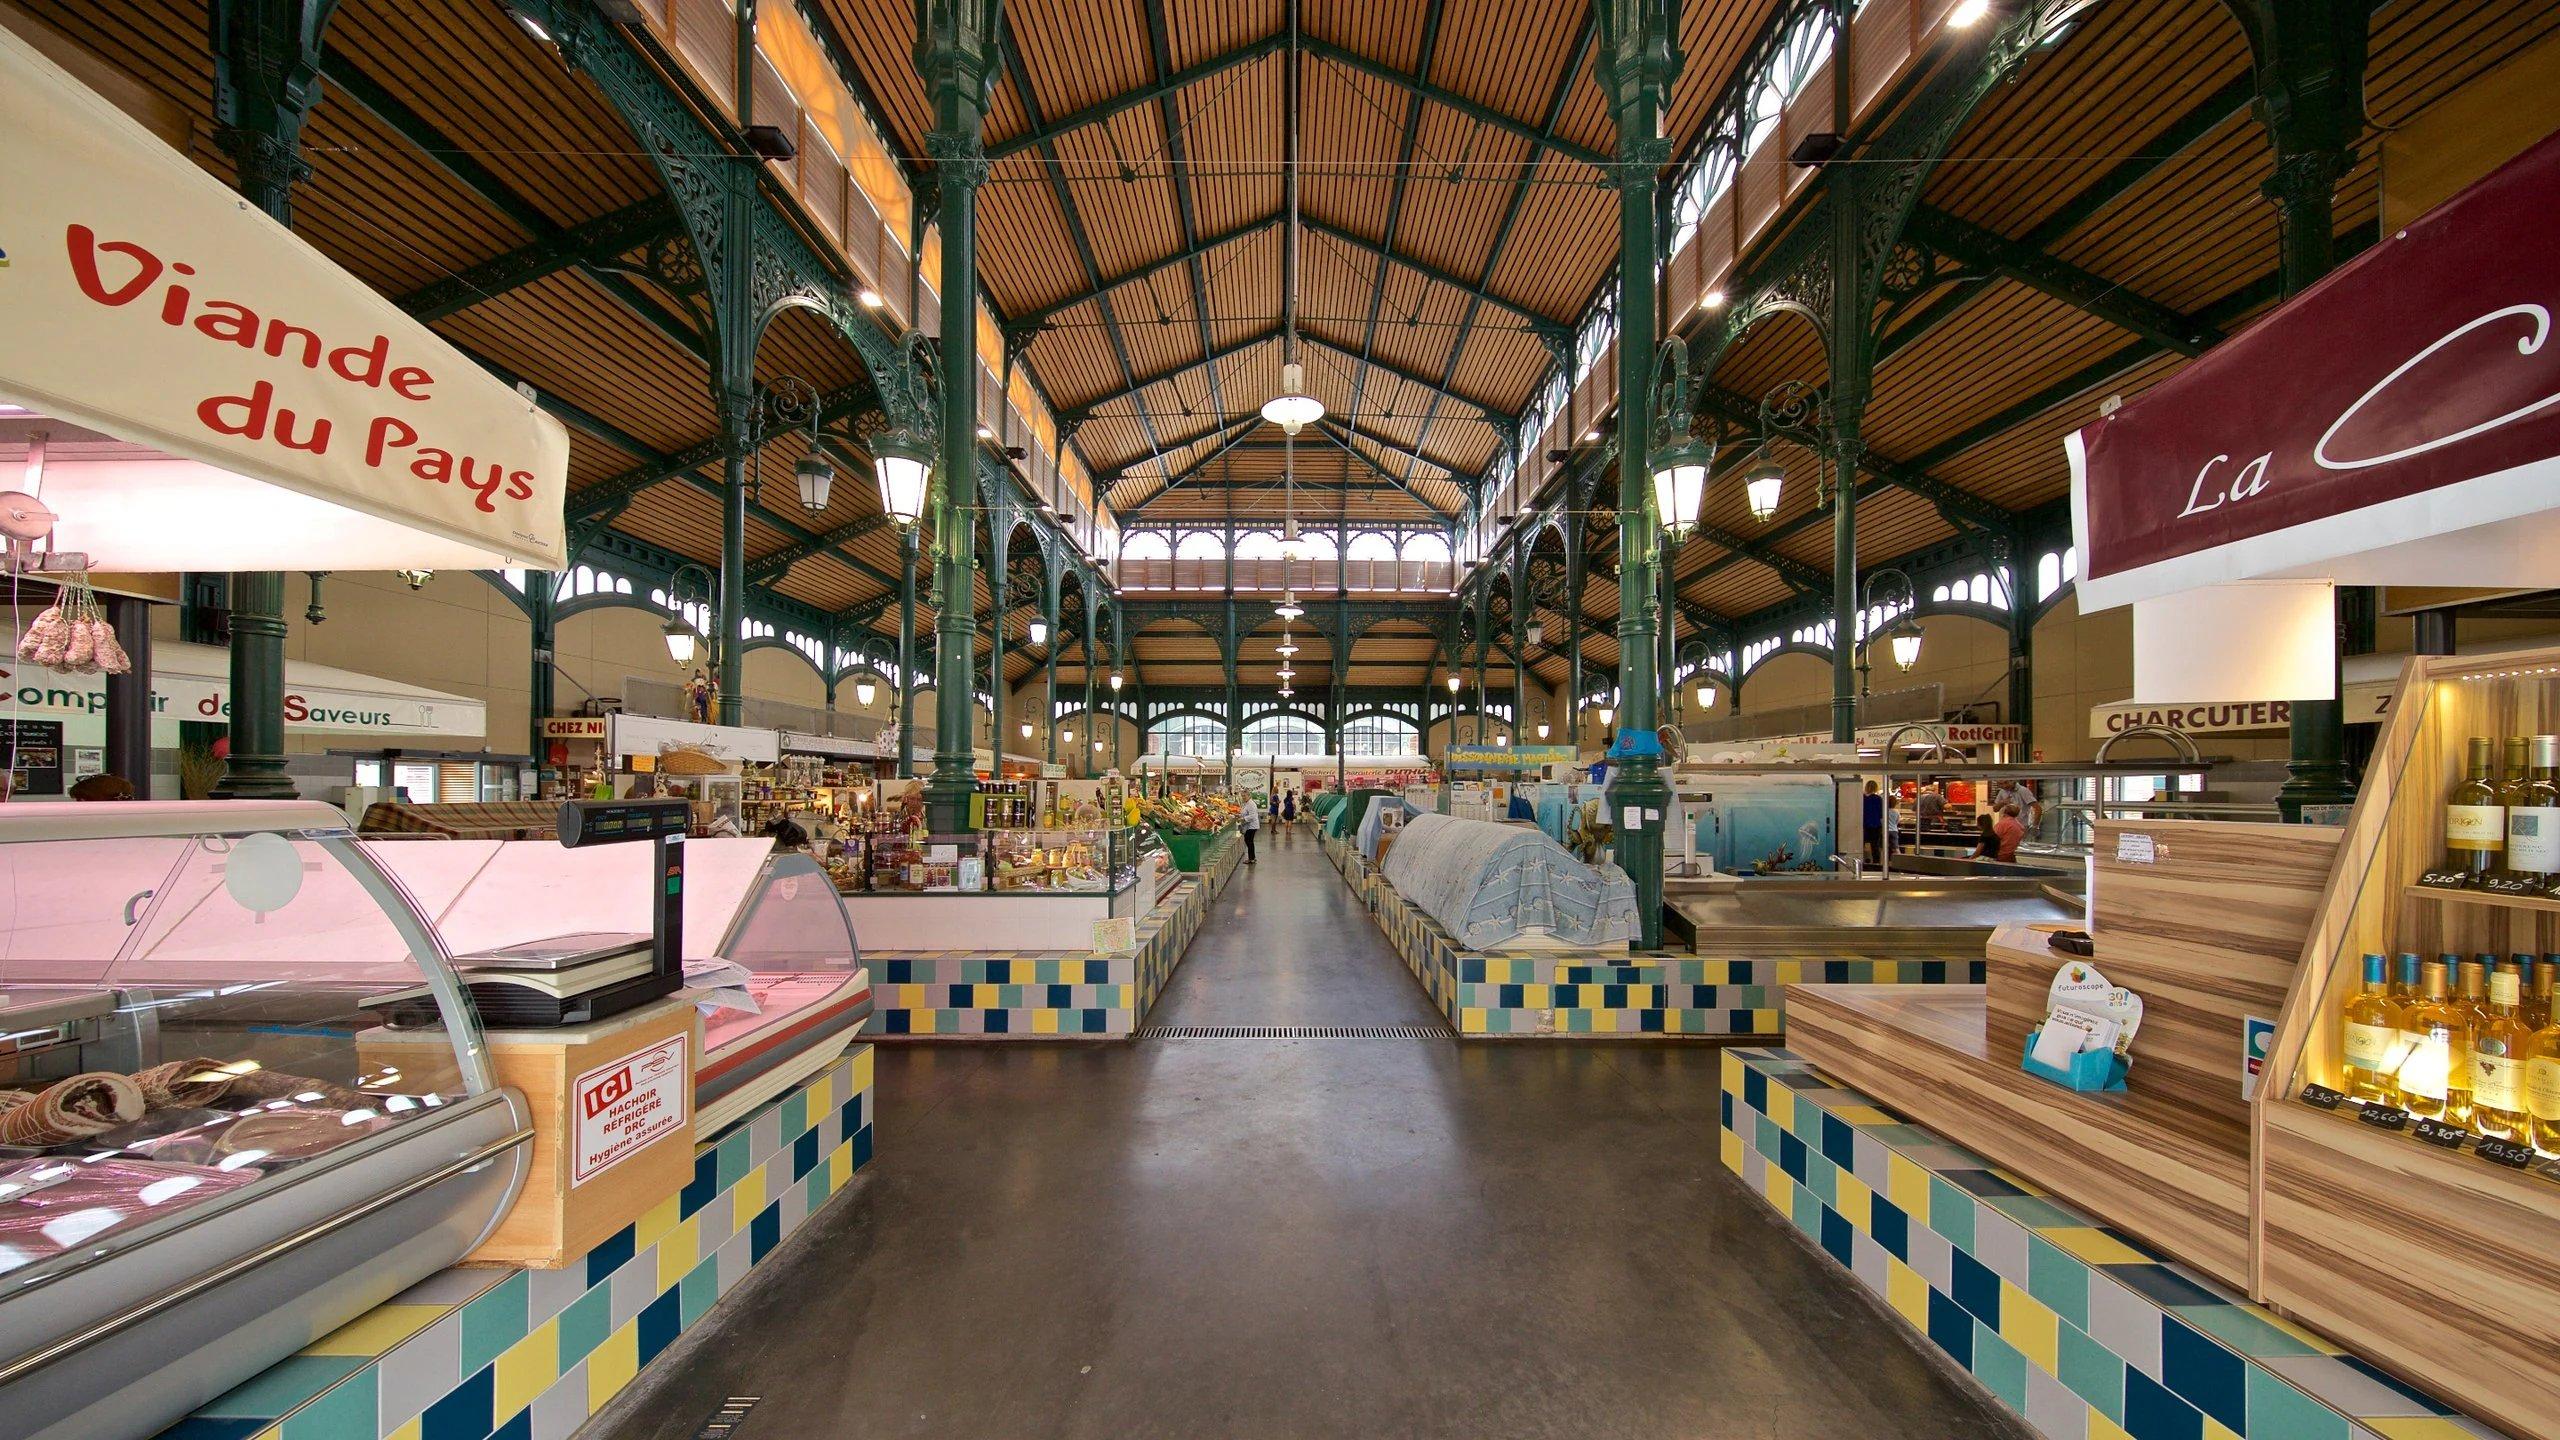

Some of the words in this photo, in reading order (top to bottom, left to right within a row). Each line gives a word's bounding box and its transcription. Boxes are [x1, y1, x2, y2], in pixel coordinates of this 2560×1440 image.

[66, 223, 435, 402] Viande
[196, 380, 332, 456] du
[364, 416, 536, 513] Pays
[2177, 450, 2273, 519] La
[0, 669, 169, 713] ompir
[283, 695, 390, 726] Saveurs
[547, 722, 583, 734] CHEZ
[2107, 701, 2290, 732] CHARCUTER
[1948, 726, 2020, 742] RotiGrill
[2423, 872, 2465, 884] 5,20€
[2488, 878, 2534, 891] 9,20€
[2058, 984, 2104, 992] futuroscope
[590, 1072, 628, 1113] ICI
[609, 1088, 657, 1118] HACHOIR
[624, 1118, 646, 1135] DRC
[2361, 1109, 2409, 1123] 12,60€
[589, 1136, 633, 1165] Hygiène
[635, 1115, 673, 1139] assurée
[2479, 1142, 2532, 1162] 19,50€
